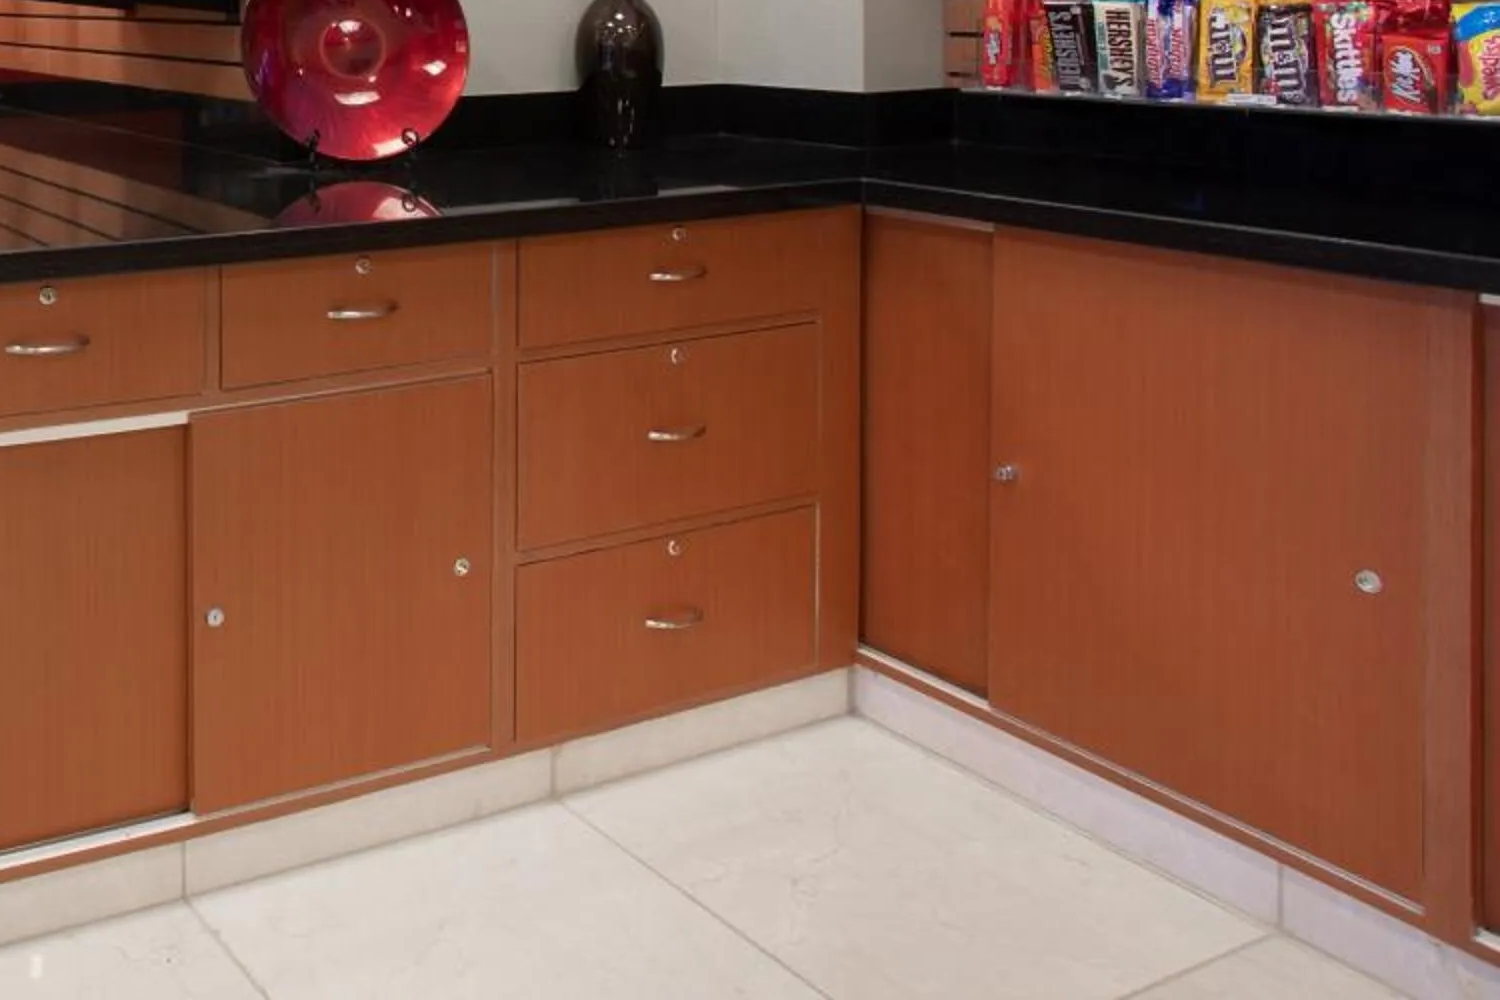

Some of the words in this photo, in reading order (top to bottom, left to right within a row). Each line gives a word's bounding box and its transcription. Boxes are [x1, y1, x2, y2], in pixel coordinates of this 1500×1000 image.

[1049, 11, 1081, 88] HERSHEY'S
[1105, 9, 1134, 86] HERSHEY'S
[1331, 12, 1363, 102] Skittles
